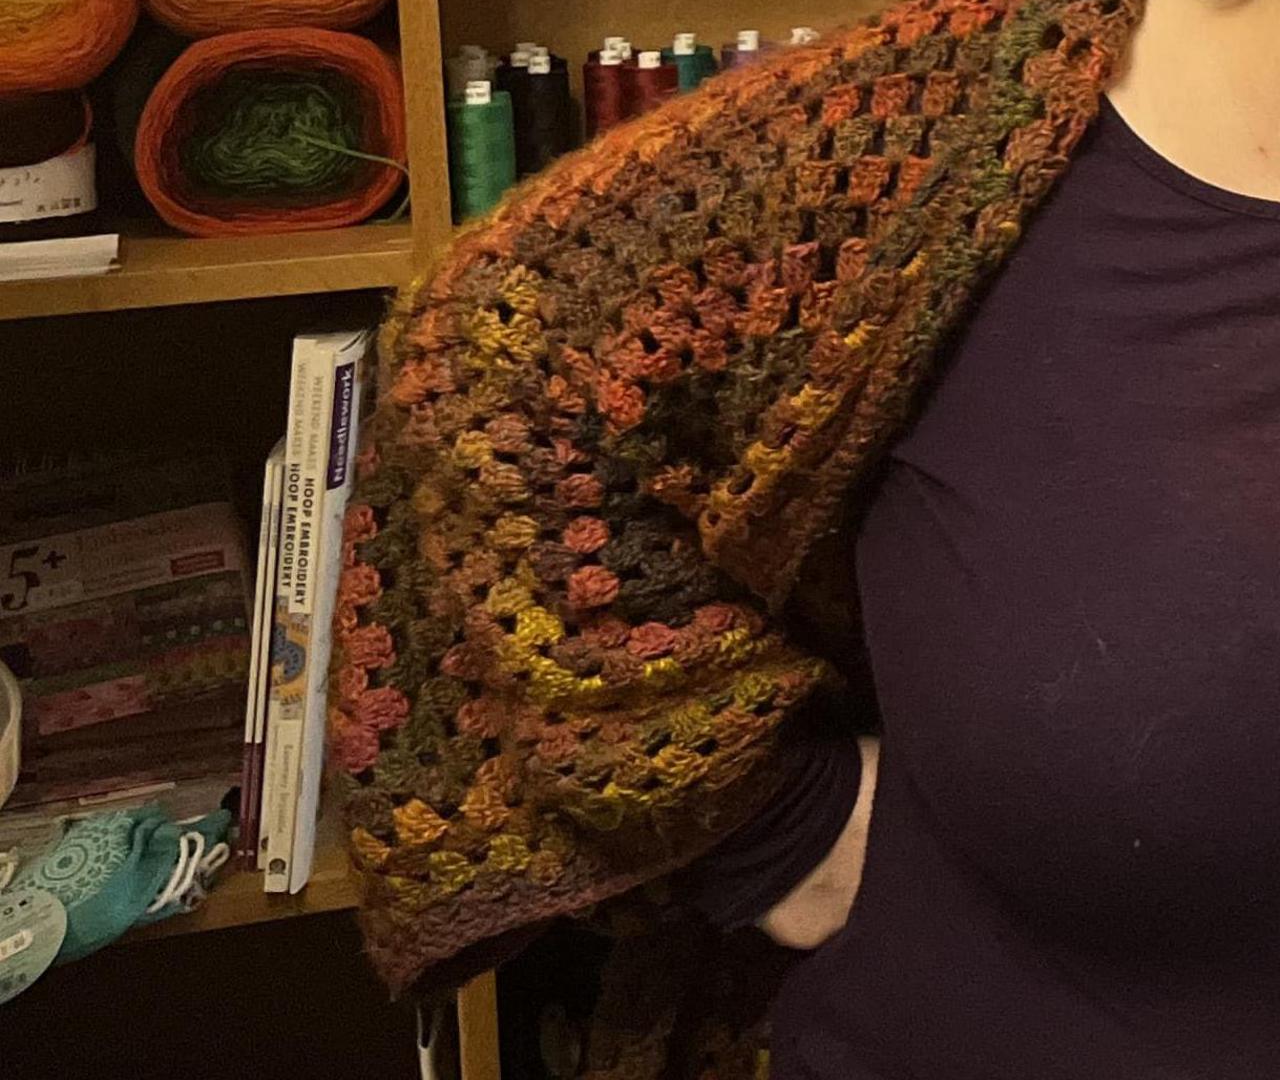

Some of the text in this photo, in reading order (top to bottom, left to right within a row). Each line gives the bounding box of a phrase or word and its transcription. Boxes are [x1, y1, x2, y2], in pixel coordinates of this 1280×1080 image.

[333, 367, 355, 484] Needlework
[288, 463, 301, 503] HOOP
[303, 477, 315, 519] HOOP
[282, 506, 298, 588] EMBROIDERY
[294, 521, 312, 607] EMBROIDERY
